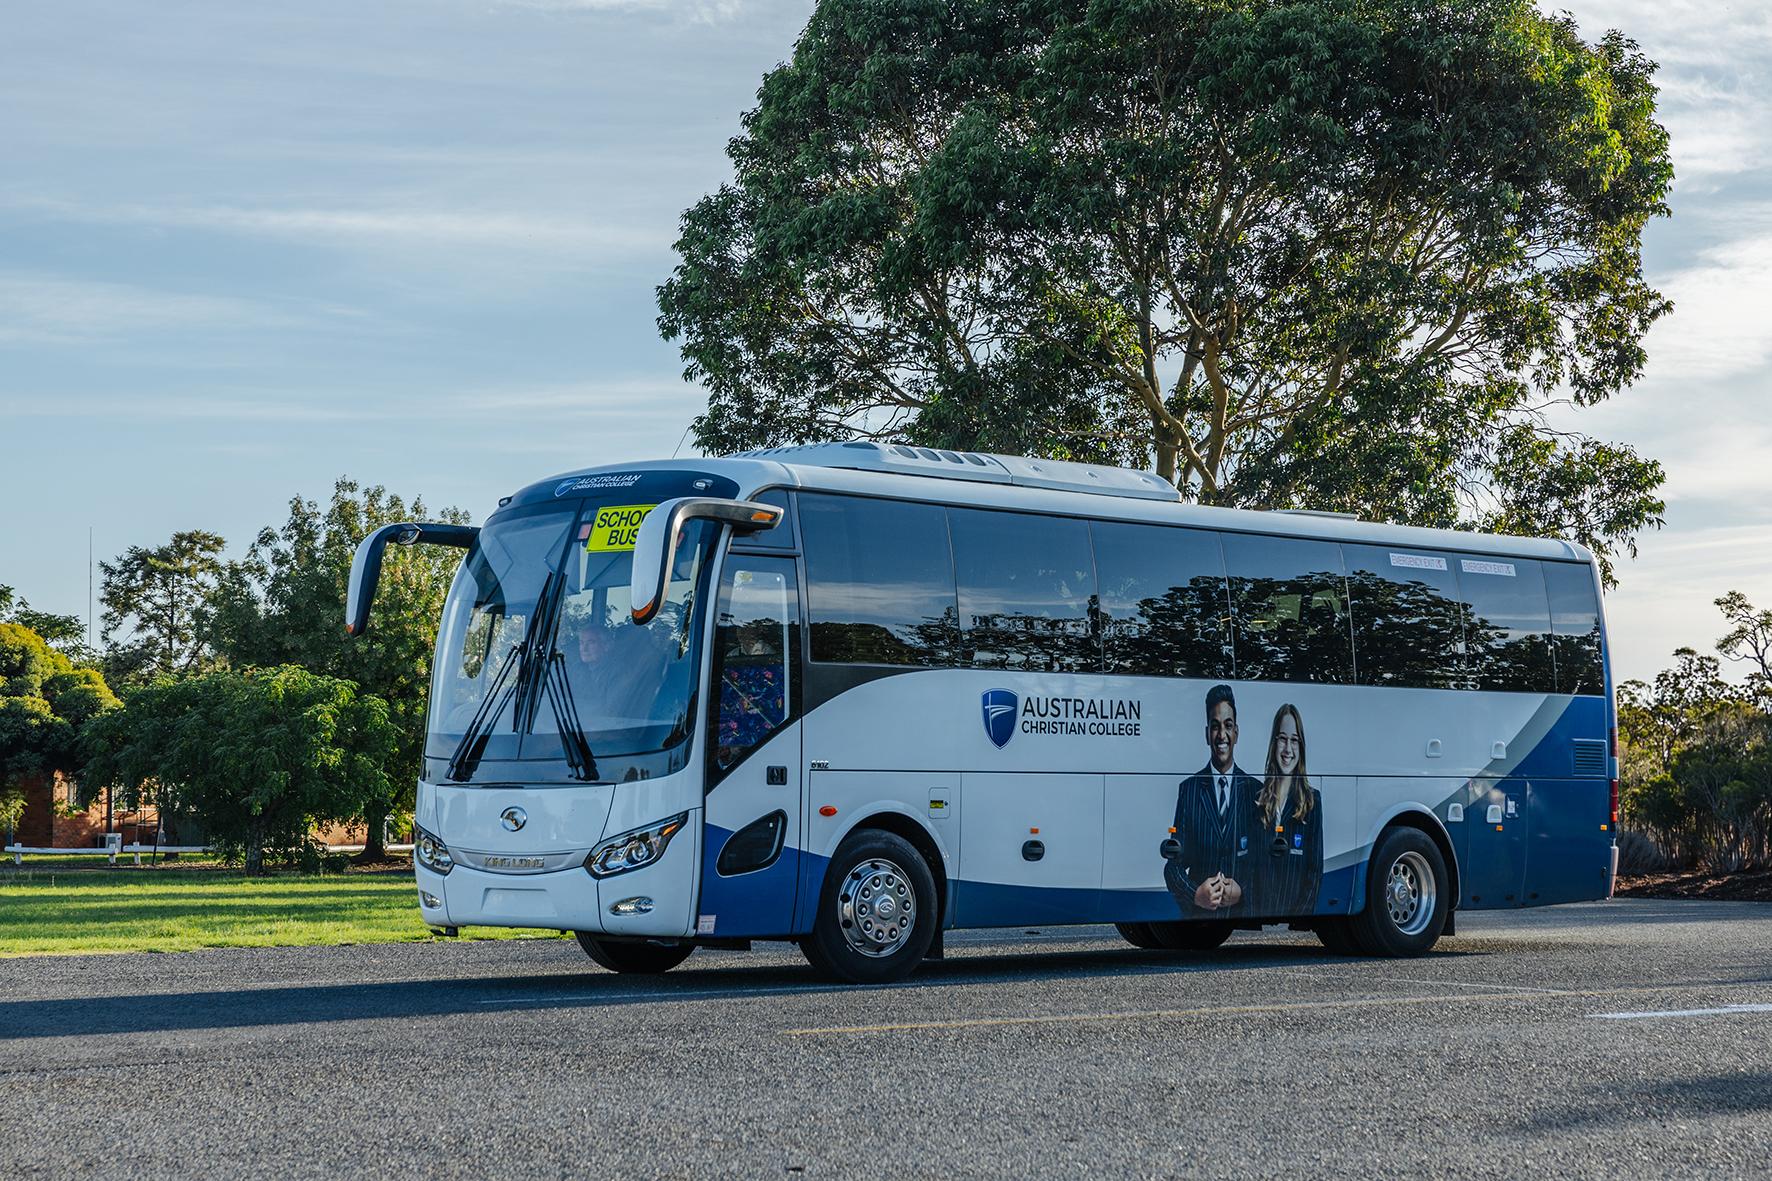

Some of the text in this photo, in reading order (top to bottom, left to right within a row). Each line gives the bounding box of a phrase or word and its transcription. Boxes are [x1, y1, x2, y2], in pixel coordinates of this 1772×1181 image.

[580, 475, 641, 484] AUSTRALIAN
[607, 529, 639, 546] BUS
[1022, 697, 1141, 720] AUSTRALIAN
[1021, 720, 1141, 736] CHRISTIAN COLLEGE
[484, 856, 545, 868] KING LONG
